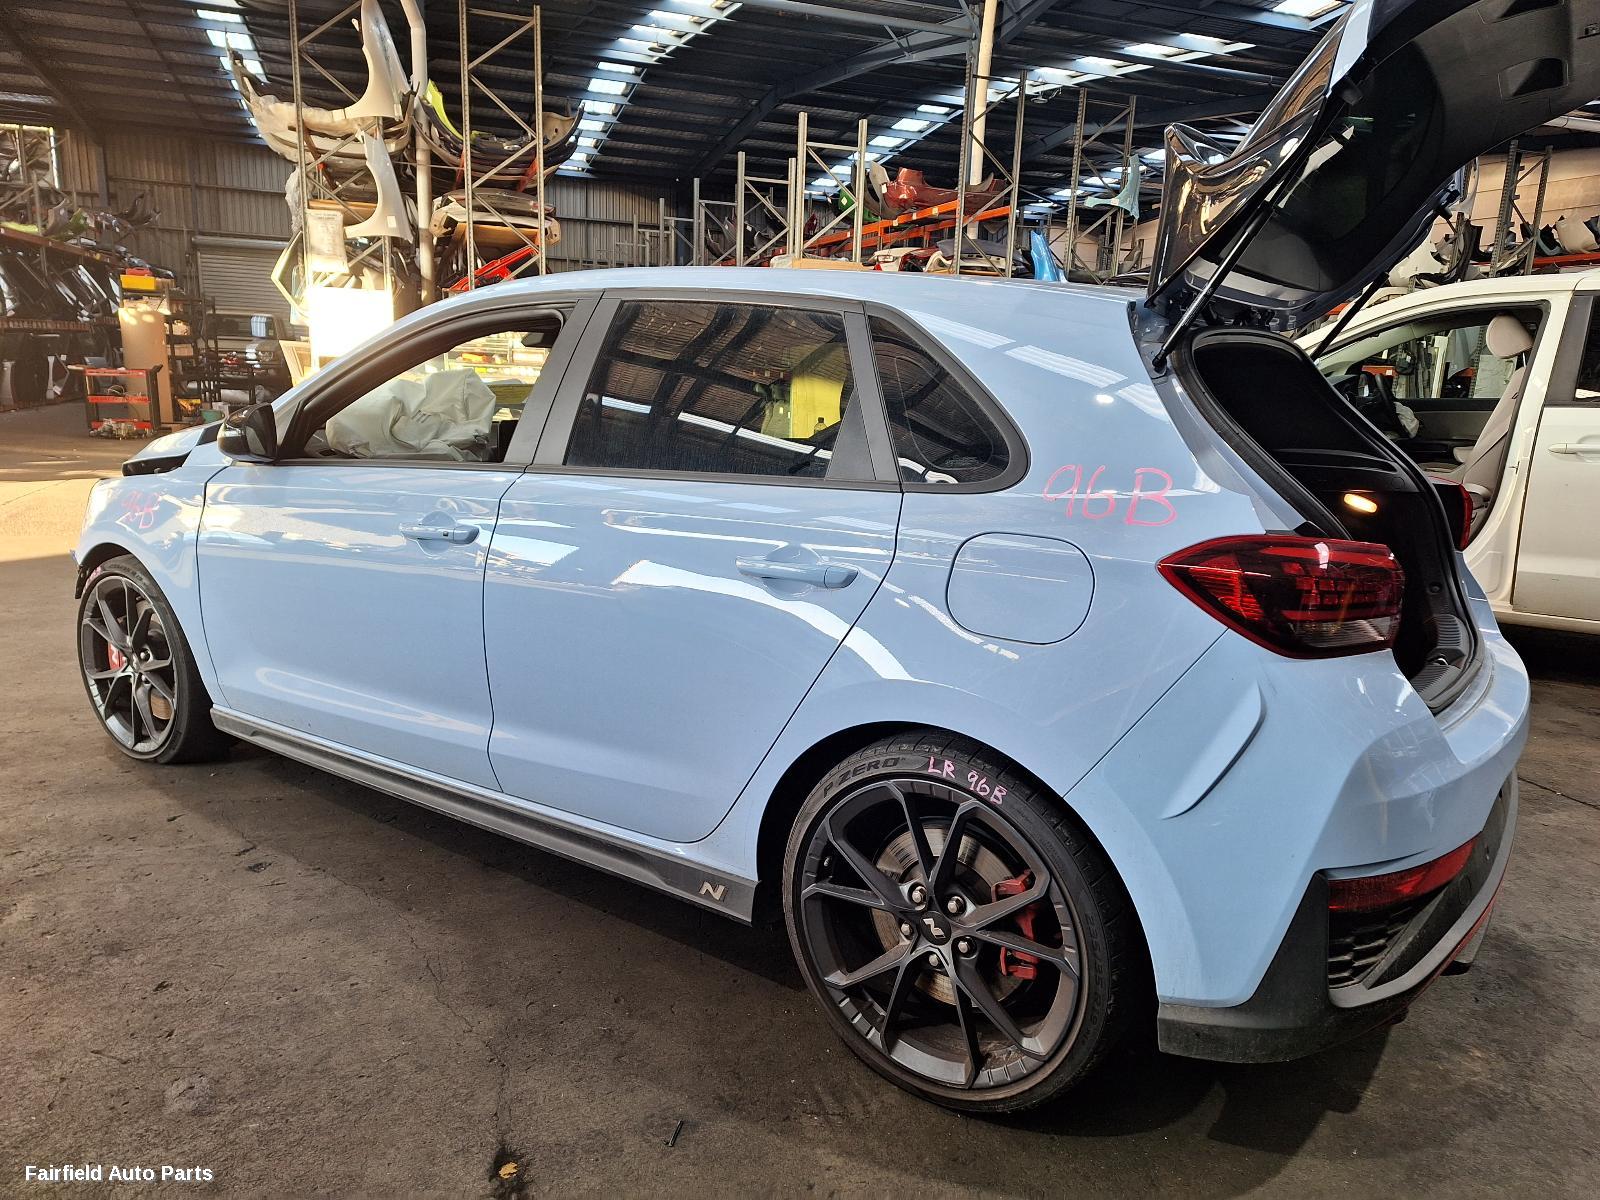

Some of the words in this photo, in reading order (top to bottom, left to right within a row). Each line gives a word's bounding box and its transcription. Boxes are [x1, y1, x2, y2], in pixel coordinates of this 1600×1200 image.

[1042, 463, 1177, 527] 96B
[838, 756, 901, 786] ZERO
[927, 755, 956, 779] LR
